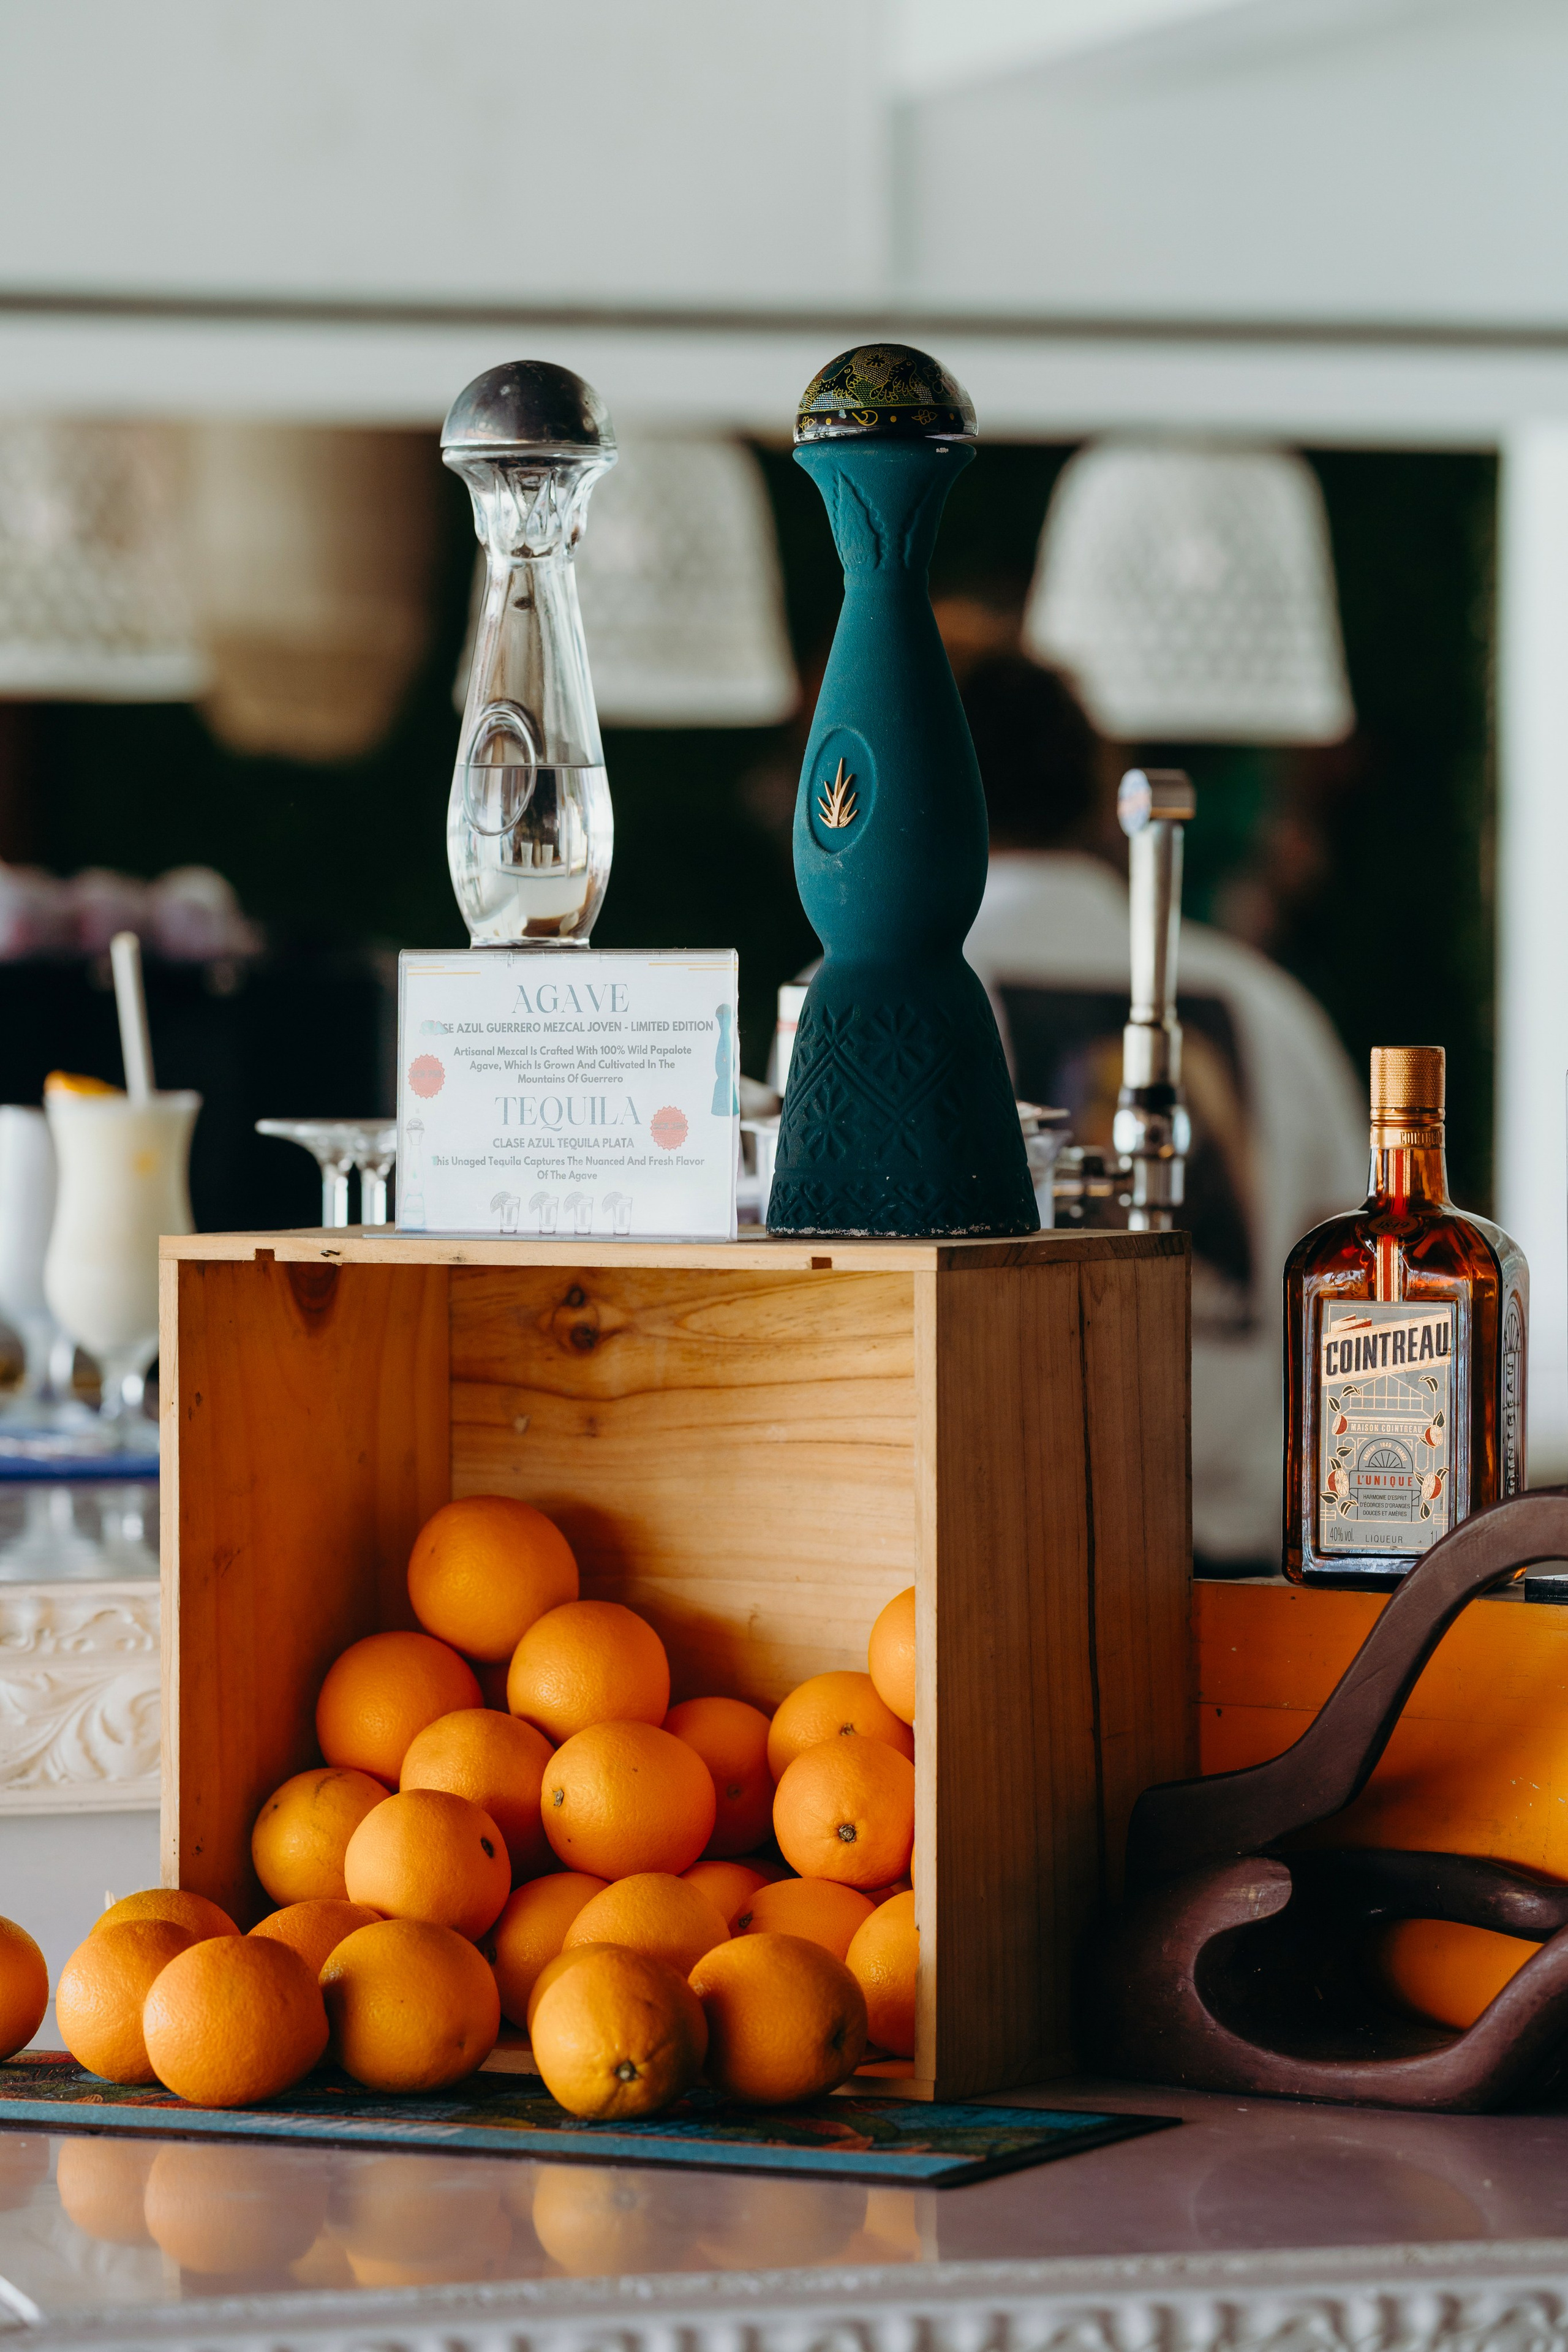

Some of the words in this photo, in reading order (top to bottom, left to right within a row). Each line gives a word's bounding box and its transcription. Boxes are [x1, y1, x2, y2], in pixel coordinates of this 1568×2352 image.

[513, 984, 628, 1013] AGAVE
[457, 1023, 484, 1033] AZUL
[486, 1022, 541, 1033] GUERRERO
[543, 1022, 585, 1032] MEZCAL
[587, 1022, 621, 1031] JOVEN
[631, 1021, 669, 1031] LIMITED
[673, 1021, 713, 1031] EDITION
[454, 1046, 494, 1056] Artisanal
[497, 1046, 527, 1055] Mezcal
[530, 1046, 537, 1055] Is
[540, 1046, 573, 1055] Crafted
[576, 1046, 598, 1055] With
[600, 1046, 625, 1055] 100%
[627, 1045, 647, 1054] Wild
[650, 1045, 692, 1057] Papalote
[470, 1061, 501, 1072] Agave,
[504, 1060, 532, 1069] Which
[535, 1060, 541, 1069] Is
[544, 1060, 575, 1069] Grown
[577, 1060, 595, 1069] And
[598, 1059, 645, 1069] Cultivated
[648, 1060, 656, 1068] In
[658, 1059, 675, 1068] The
[518, 1074, 565, 1083] Mountains
[568, 1073, 579, 1083] Of
[581, 1074, 623, 1083] Guerrero
[495, 1096, 641, 1131] TEQUILA
[493, 1138, 525, 1148] CLASE
[527, 1138, 555, 1148] AZUL
[557, 1138, 600, 1150] TEQUILA
[603, 1138, 634, 1148] PLATA
[451, 1156, 486, 1168] Unaged
[488, 1156, 521, 1167] Tequila
[524, 1156, 565, 1167] Captures
[567, 1156, 583, 1165] The
[586, 1156, 624, 1165] Nuanced
[627, 1156, 646, 1165] And
[649, 1156, 673, 1165] Fresh
[676, 1156, 704, 1165] Flavor
[537, 1170, 548, 1179] Of
[550, 1170, 566, 1179] The
[568, 1170, 597, 1182] Agave
[1325, 1322, 1449, 1376] COINTREAU
[1351, 1423, 1379, 1432] MAISON
[1382, 1424, 1422, 1433] COINTREAU
[1395, 1446, 1408, 1461] FRANCE
[1357, 1475, 1413, 1487] L'UNIQUE
[1330, 1527, 1343, 1542] 40%
[1344, 1528, 1354, 1542] vol.
[1365, 1535, 1403, 1544] LIQUEUR
